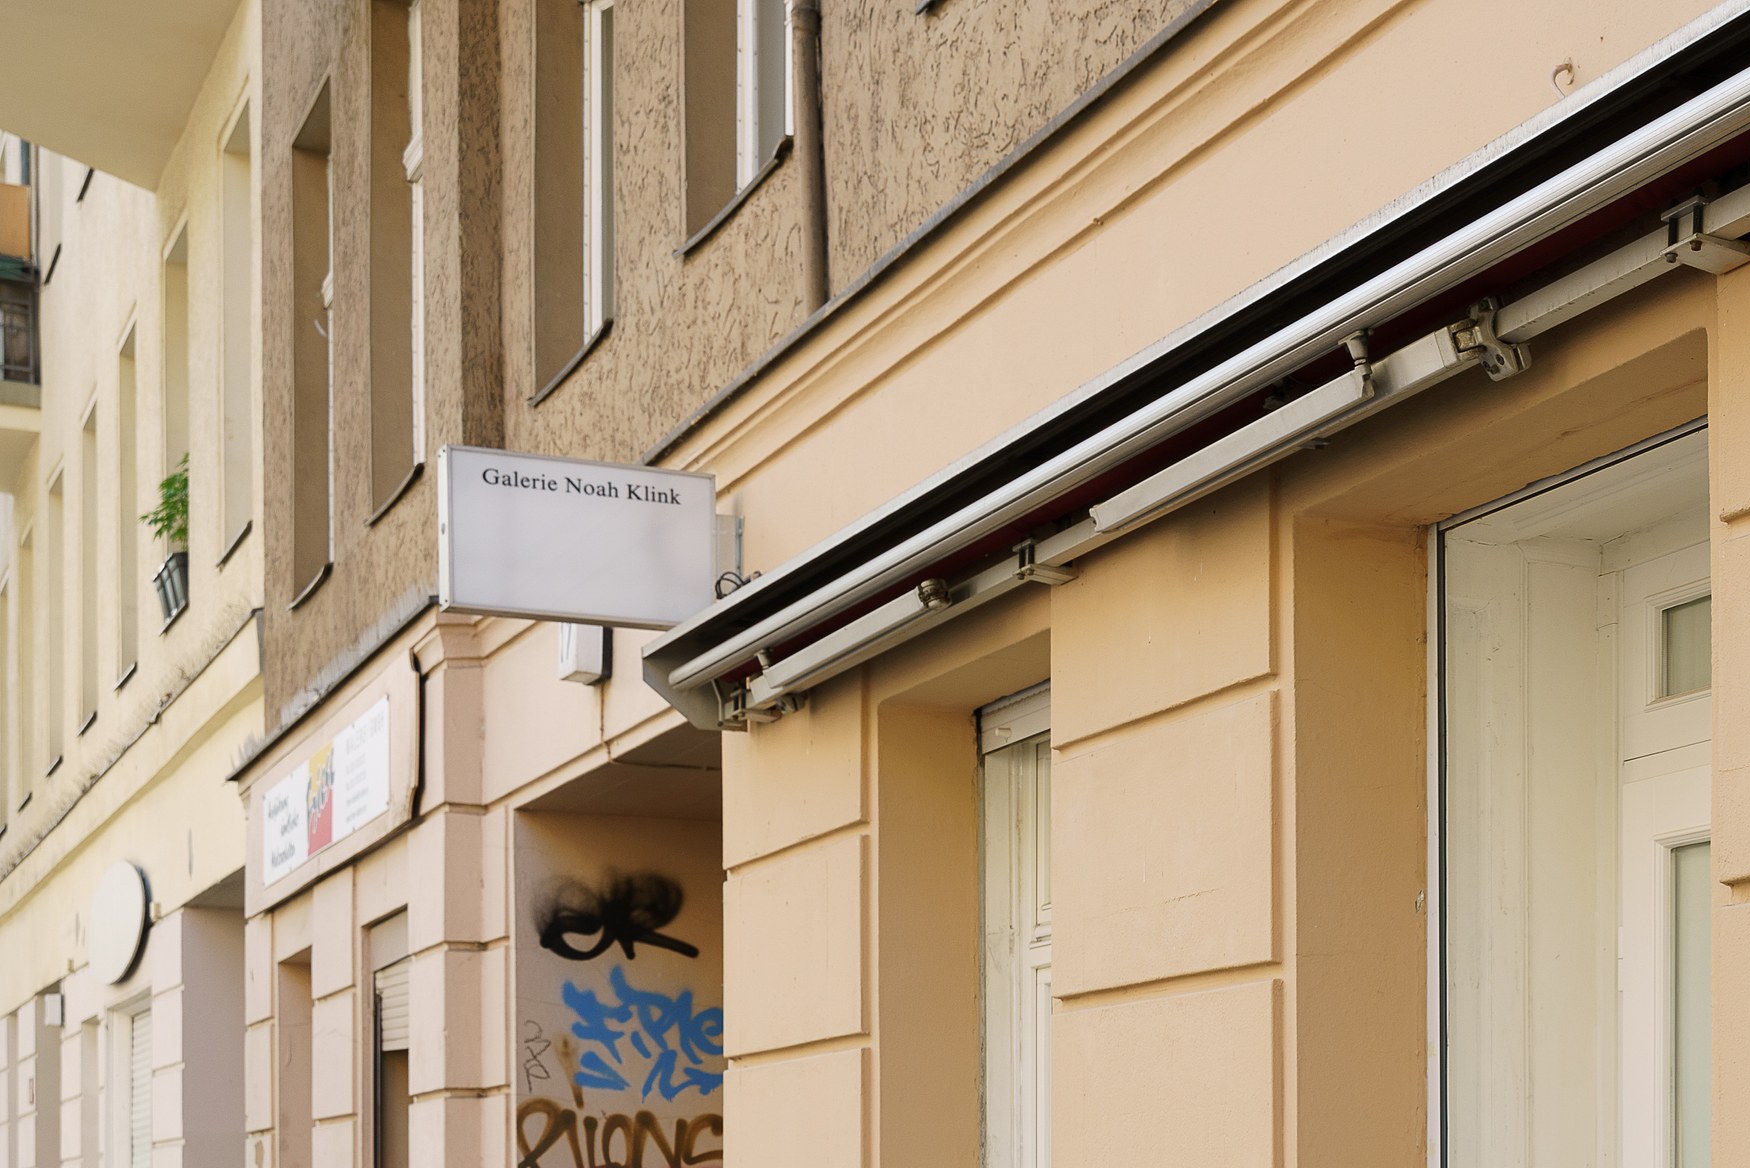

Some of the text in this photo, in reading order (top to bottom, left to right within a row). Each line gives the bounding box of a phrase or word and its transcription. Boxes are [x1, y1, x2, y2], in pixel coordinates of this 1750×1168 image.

[481, 467, 683, 505] Galerie Noah Klink
